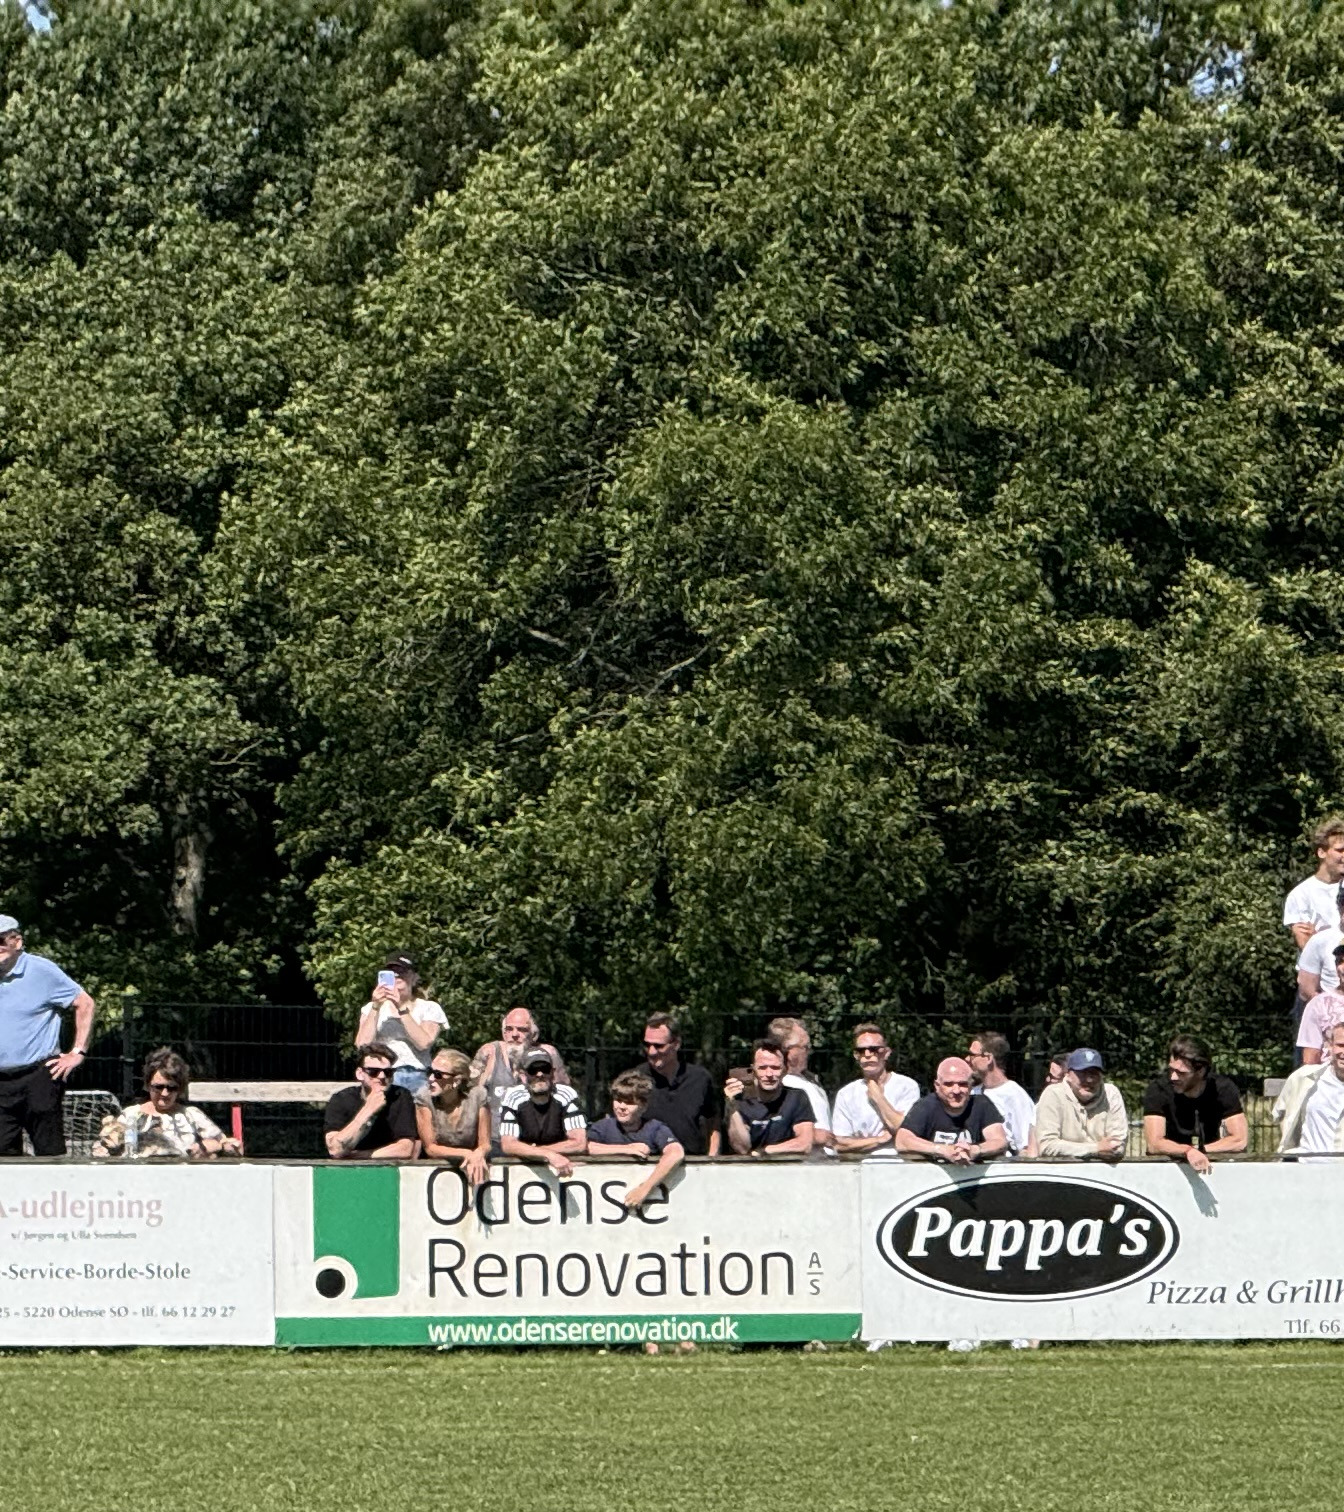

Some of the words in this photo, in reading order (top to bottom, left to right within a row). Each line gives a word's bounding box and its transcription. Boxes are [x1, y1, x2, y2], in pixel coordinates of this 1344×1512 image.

[426, 1167, 671, 1226] Odense
[907, 1204, 1151, 1271] Pappa's
[429, 1236, 795, 1298] Renovation
[1147, 1281, 1227, 1305] Pizza
[1236, 1280, 1258, 1304] &
[23, 1306, 55, 1319] 5220
[58, 1305, 106, 1319] Odense
[183, 1306, 197, 1318] 12
[201, 1306, 217, 1318] 29
[220, 1306, 236, 1318] 27
[428, 1315, 740, 1343] www.odenserenovation.dk
[1284, 1319, 1313, 1335] Tlf.
[1319, 1319, 1341, 1334] 66
